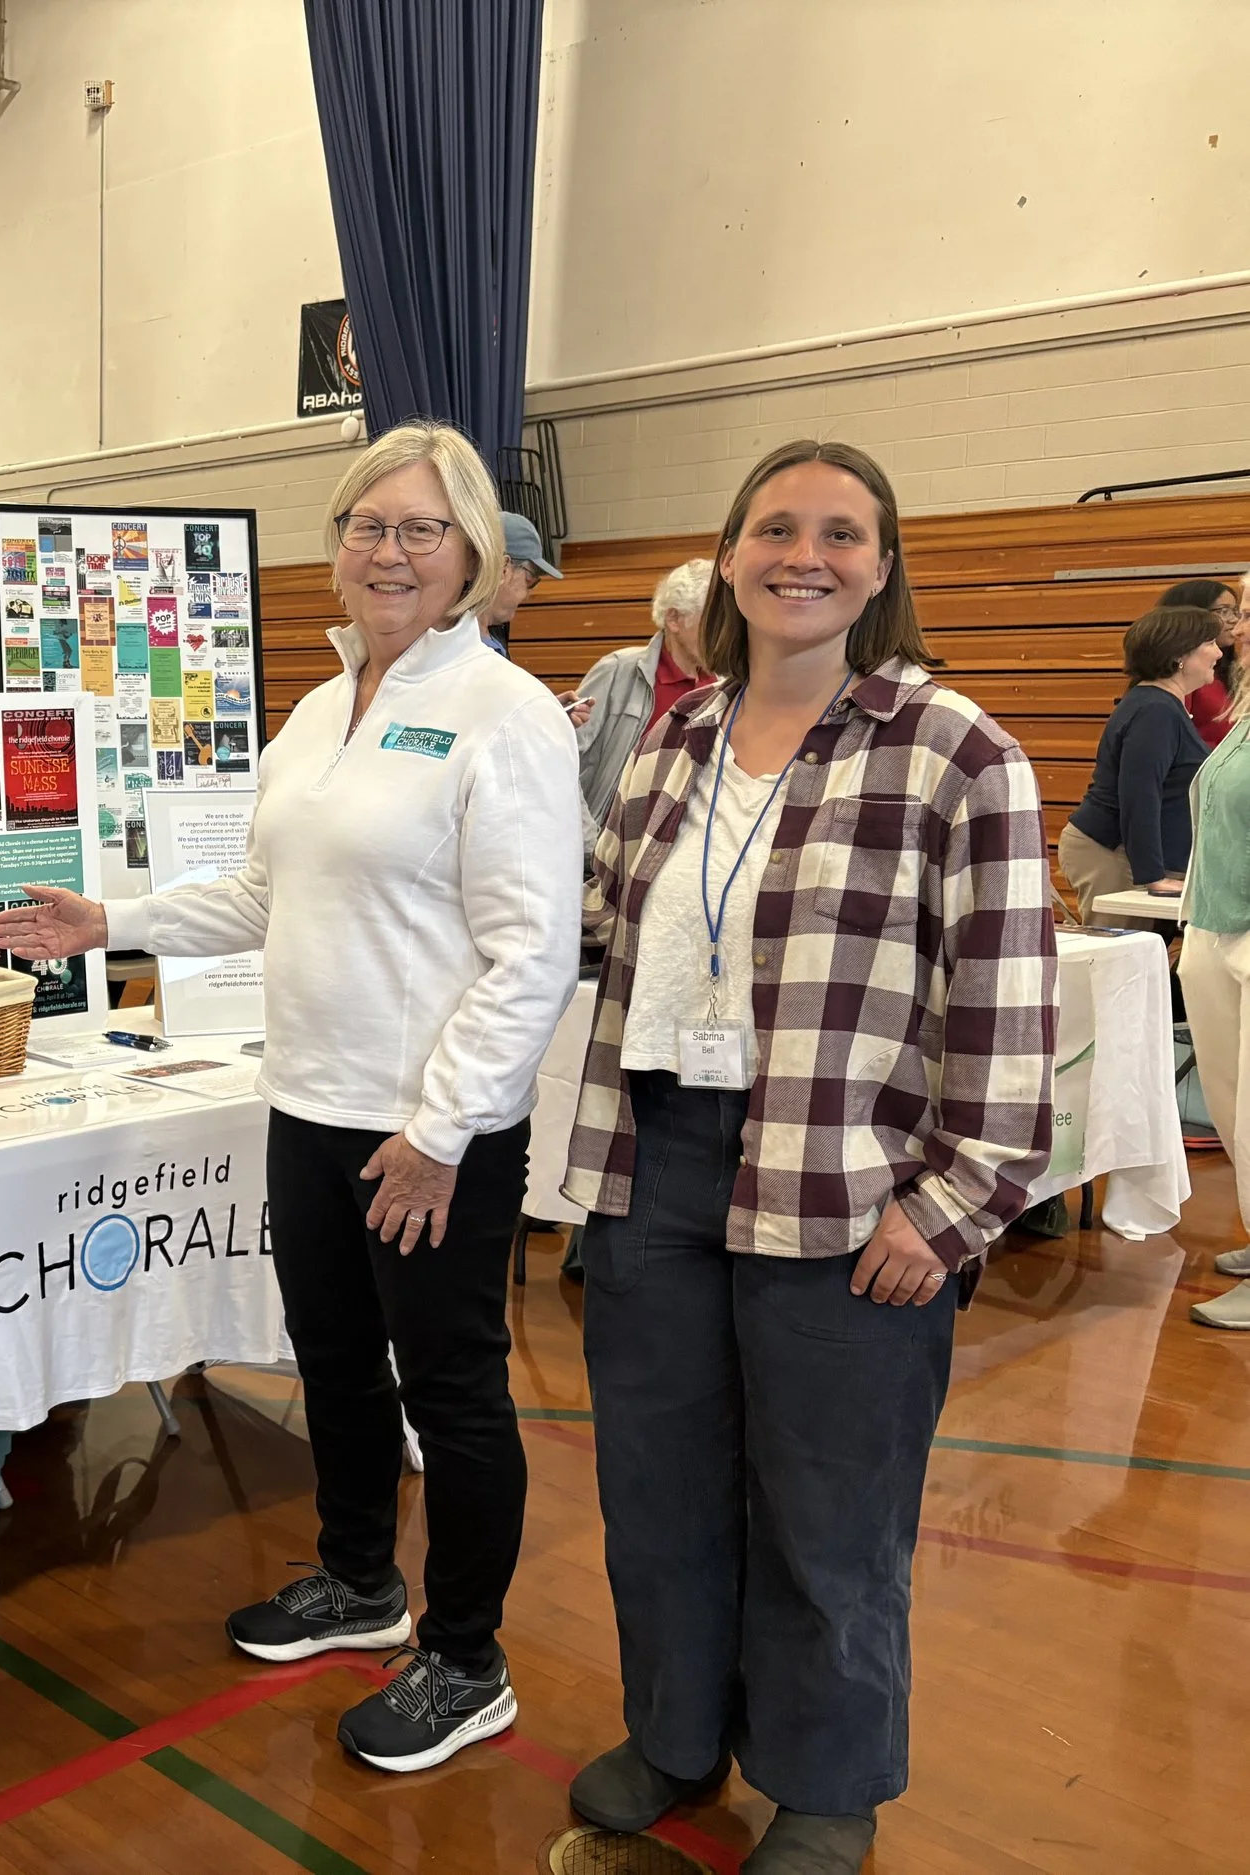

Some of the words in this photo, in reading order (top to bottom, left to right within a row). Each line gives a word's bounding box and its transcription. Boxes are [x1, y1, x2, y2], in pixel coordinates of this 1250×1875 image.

[112, 522, 146, 531] CONCERT
[184, 524, 218, 532] CONCERT
[193, 532, 212, 542] TOP
[193, 544, 212, 556] 40
[87, 562, 106, 570] TIME
[155, 614, 172, 623] POP
[3, 709, 74, 719] CONCERT
[8, 736, 18, 744] the
[18, 736, 48, 746] ridgefield
[48, 735, 71, 743] chorale
[400, 731, 453, 745] RIDGEFIELD
[397, 738, 437, 750] CHORALE
[10, 758, 71, 776] SUNRISE
[23, 775, 58, 792] MASS
[36, 983, 64, 993] CHORALE
[38, 1001, 86, 1014] ridgefieldchorale.org
[692, 1031, 725, 1041] Sabrina
[701, 1046, 715, 1054] Bell
[693, 1073, 729, 1083] CHORALE
[20, 1083, 102, 1100] ridgefield
[0, 1084, 152, 1114] CHORALE
[58, 1154, 231, 1213] ridgefield
